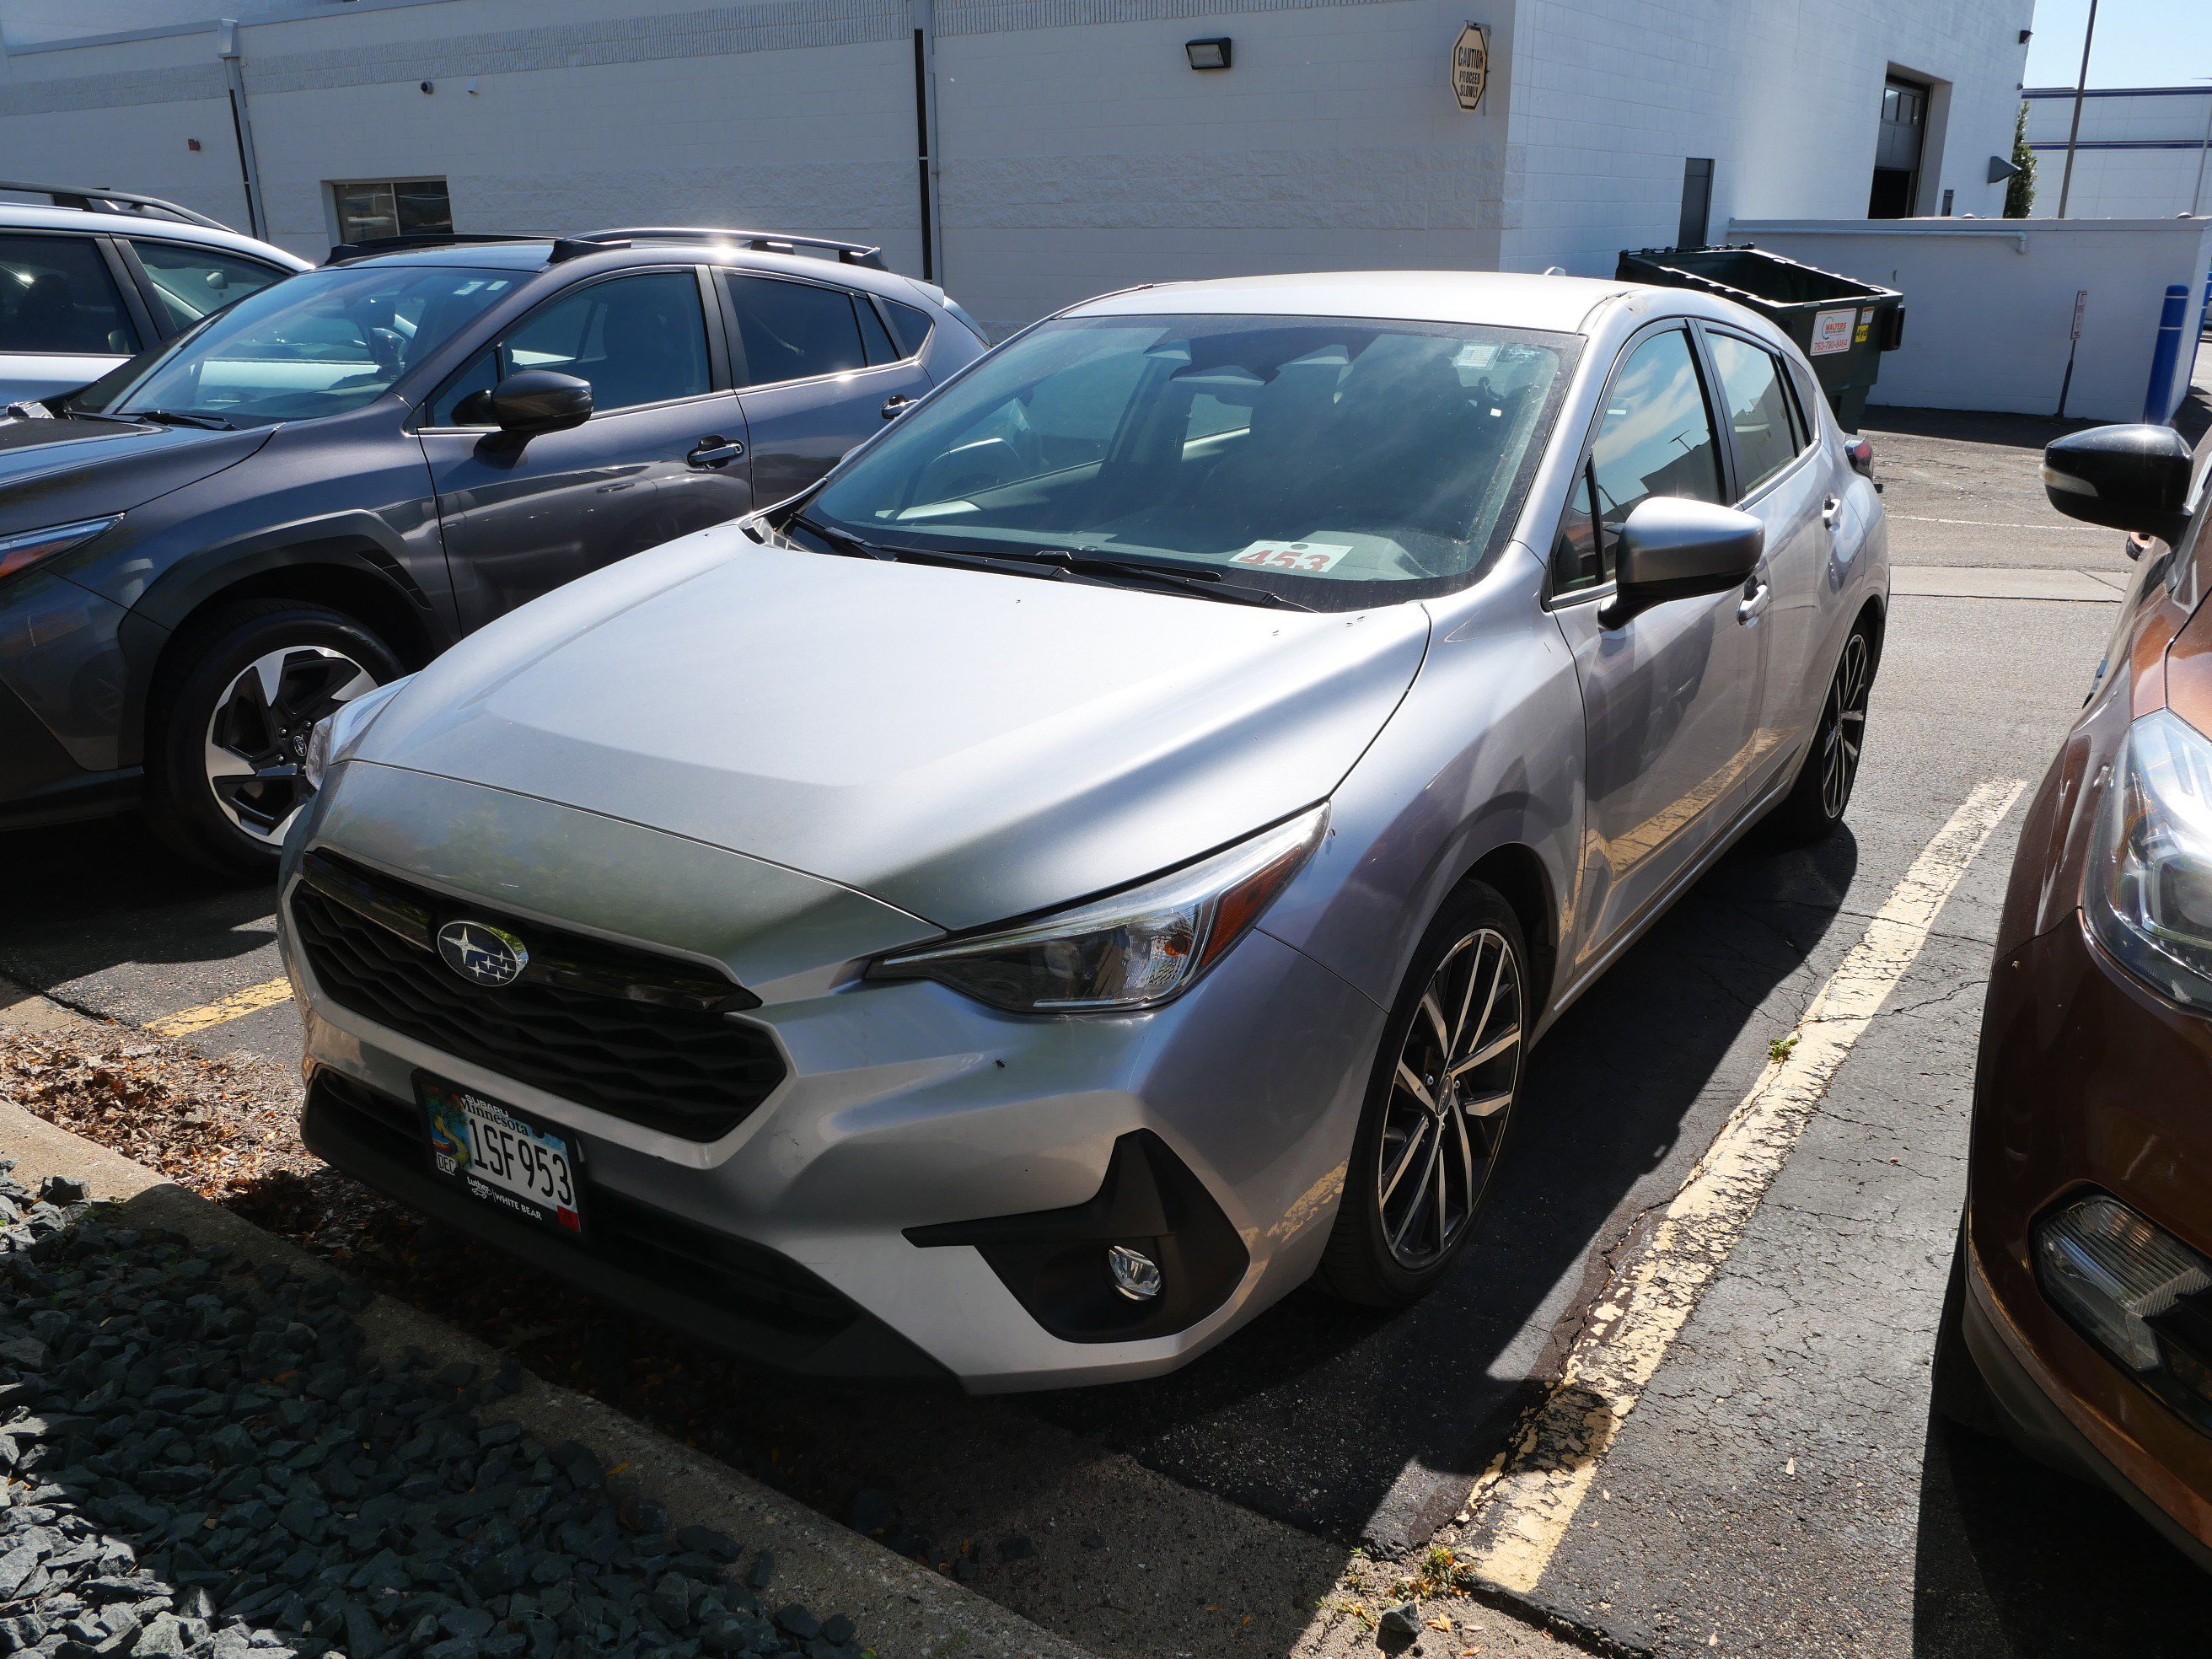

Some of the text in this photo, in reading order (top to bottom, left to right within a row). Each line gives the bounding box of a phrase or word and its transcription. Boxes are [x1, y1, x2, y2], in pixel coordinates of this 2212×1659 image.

[1458, 46, 1483, 69] CAUTION
[1459, 70, 1479, 84] PROCEED
[1460, 84, 1478, 98] SLOWLY
[1238, 550, 1331, 572] 453
[459, 1097, 529, 1136] Minnesota
[464, 1093, 509, 1118] SUBARU
[438, 1154, 456, 1173] DEC
[469, 1118, 572, 1205] 1SF953
[466, 1176, 490, 1191] Luther
[494, 1192, 519, 1211] WHITE
[521, 1204, 543, 1221] BEAR
